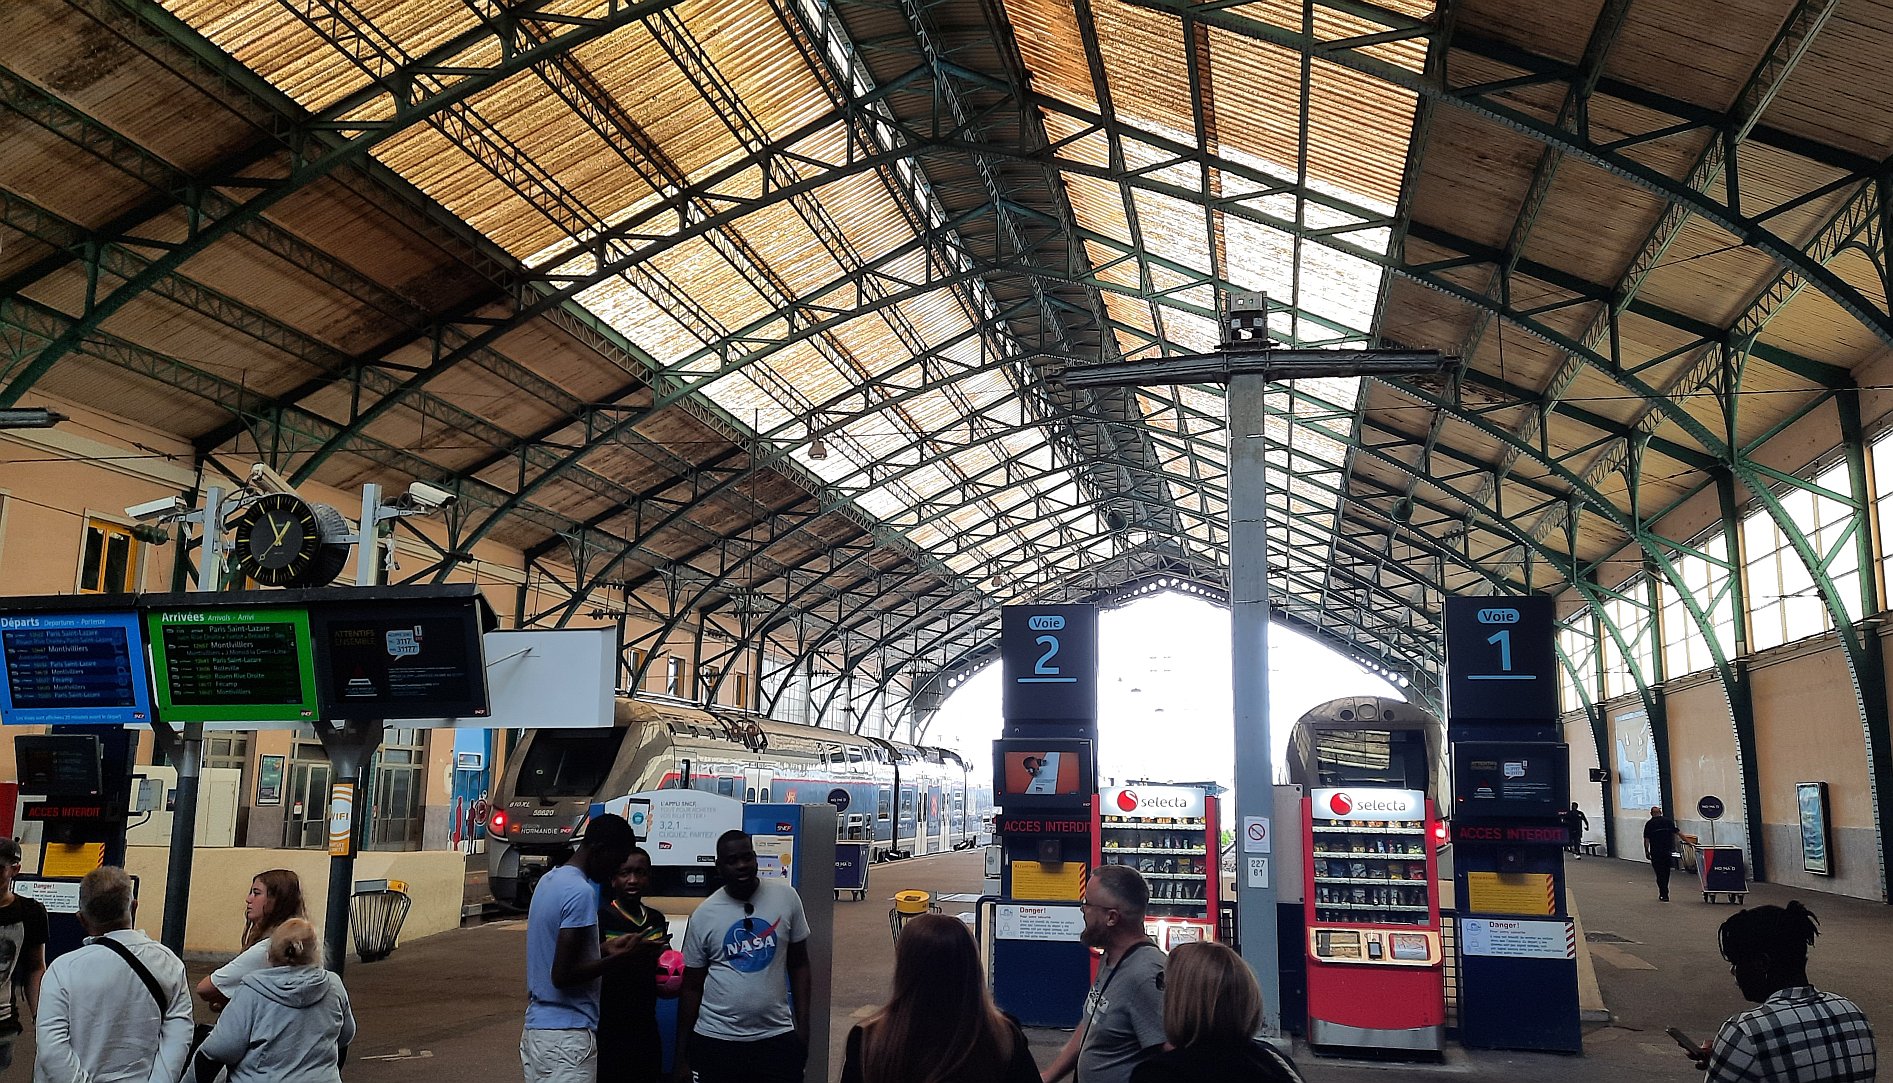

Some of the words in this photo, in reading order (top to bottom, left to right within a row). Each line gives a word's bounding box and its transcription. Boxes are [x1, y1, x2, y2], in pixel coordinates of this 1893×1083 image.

[162, 612, 204, 622] Arrivées
[208, 614, 231, 622] Arrivals
[1482, 610, 1514, 622] Voie
[1, 618, 40, 629] Départs
[1033, 618, 1060, 628] Voie
[1034, 634, 1060, 674] 2
[1487, 630, 1512, 671] 1
[1141, 797, 1187, 808] selecta
[1357, 800, 1406, 810] selecta
[28, 807, 60, 817] ACCES
[62, 806, 102, 817] INTERDIT
[660, 821, 680, 830] 3,2,1
[1004, 821, 1040, 832] ACCES
[1460, 827, 1502, 840] ACCES
[1506, 828, 1561, 840] INTERDIT
[1251, 860, 1265, 868] 227
[1020, 906, 1046, 914] Danger!
[1489, 922, 1520, 930] Danger!
[726, 935, 776, 956] NASA
